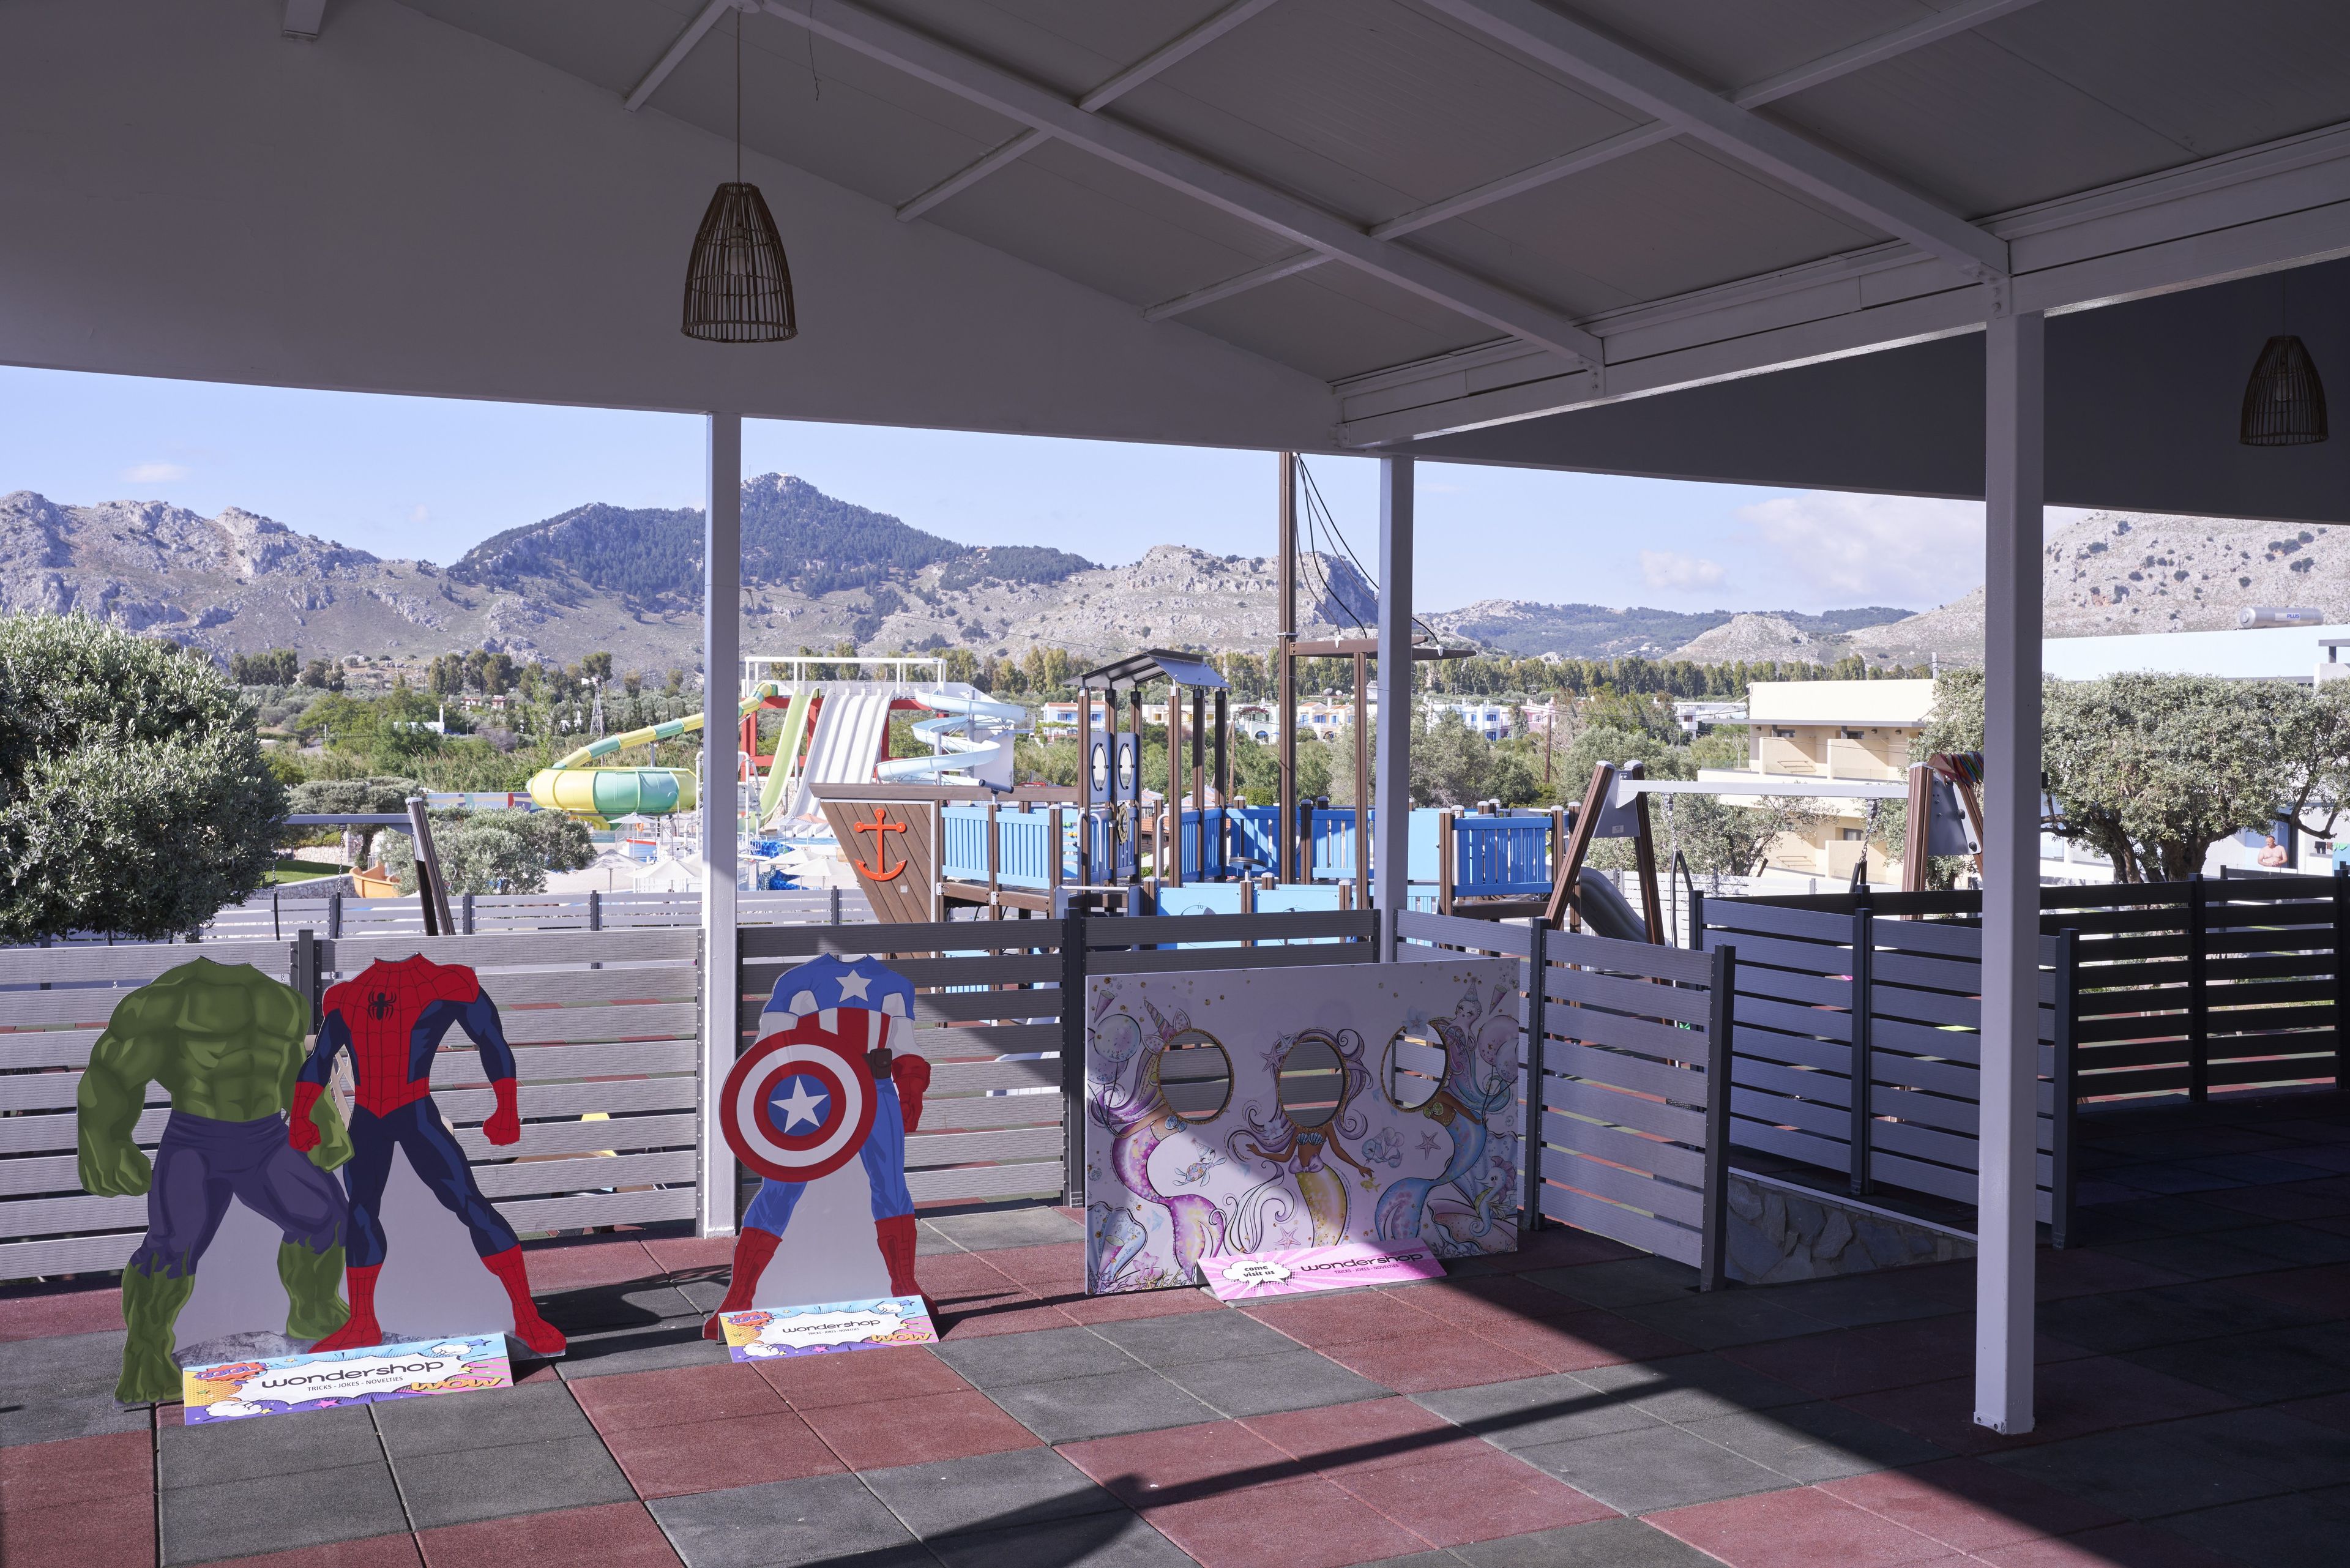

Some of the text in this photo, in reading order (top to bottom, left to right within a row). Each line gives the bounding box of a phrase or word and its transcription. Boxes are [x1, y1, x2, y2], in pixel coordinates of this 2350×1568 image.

[1300, 1254, 1423, 1272] wondershop
[782, 1319, 881, 1333] wondershop
[871, 1333, 930, 1342] WOW
[261, 1361, 444, 1388] wondershop
[365, 1376, 404, 1385] NOVELTIES
[411, 1377, 502, 1391] WOW
